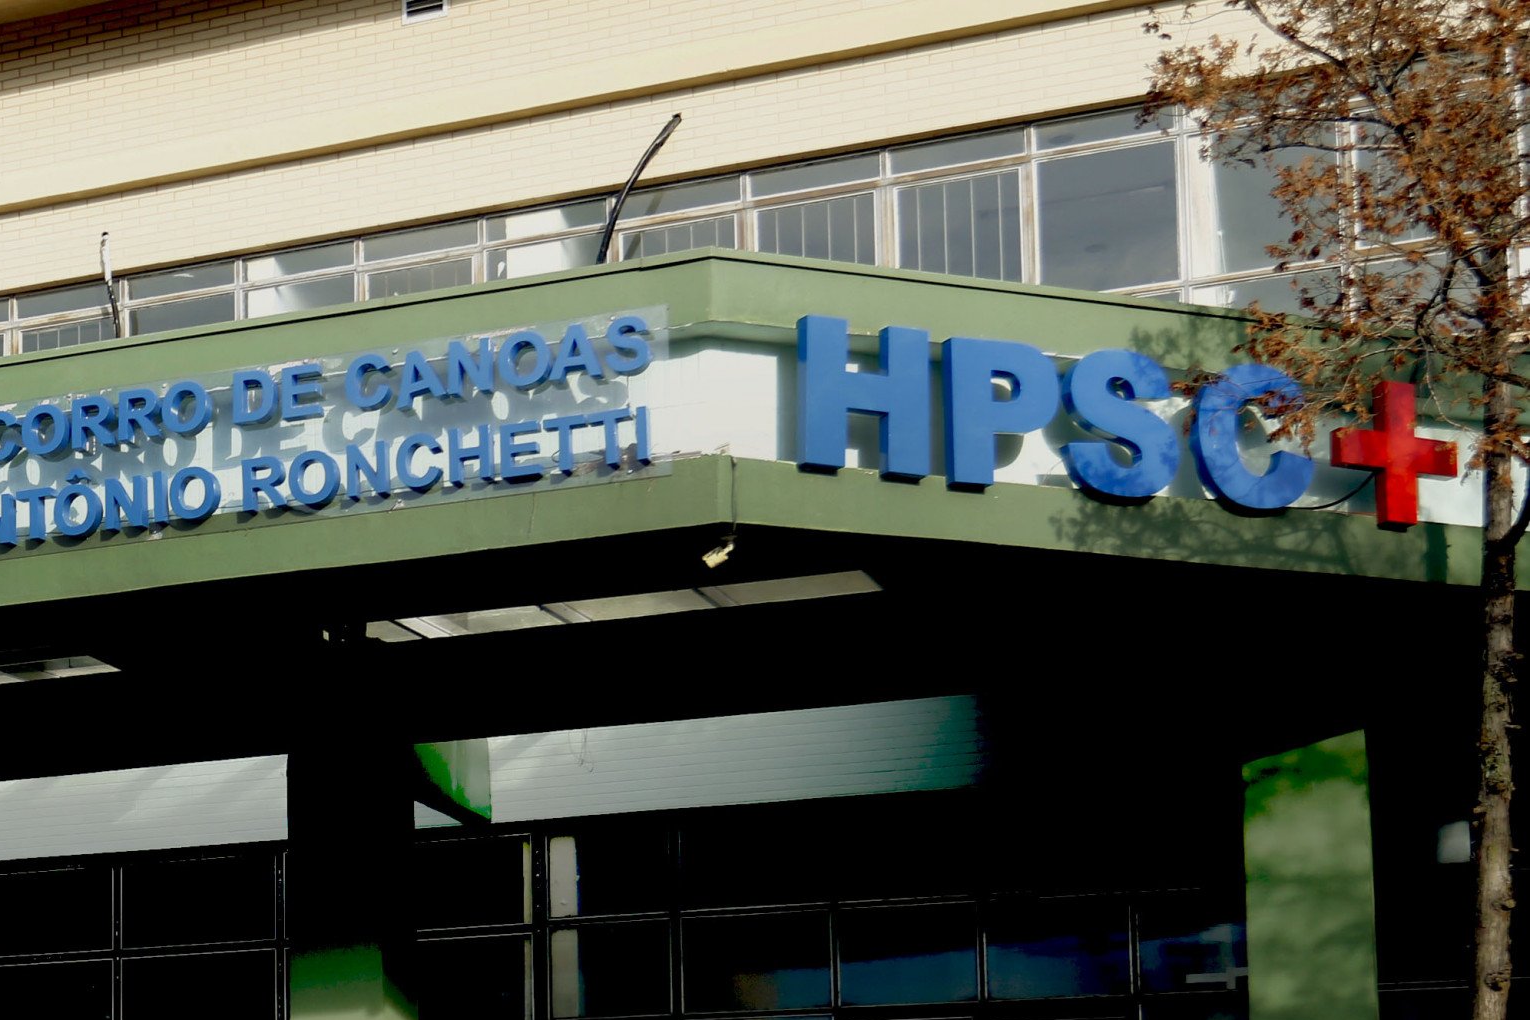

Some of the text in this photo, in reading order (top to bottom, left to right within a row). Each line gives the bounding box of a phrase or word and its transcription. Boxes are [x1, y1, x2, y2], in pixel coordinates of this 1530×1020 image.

[231, 362, 324, 426] DE
[345, 315, 652, 410] CANOAS
[796, 315, 1315, 515] HPSC
[240, 406, 652, 514] RONCHETTI
